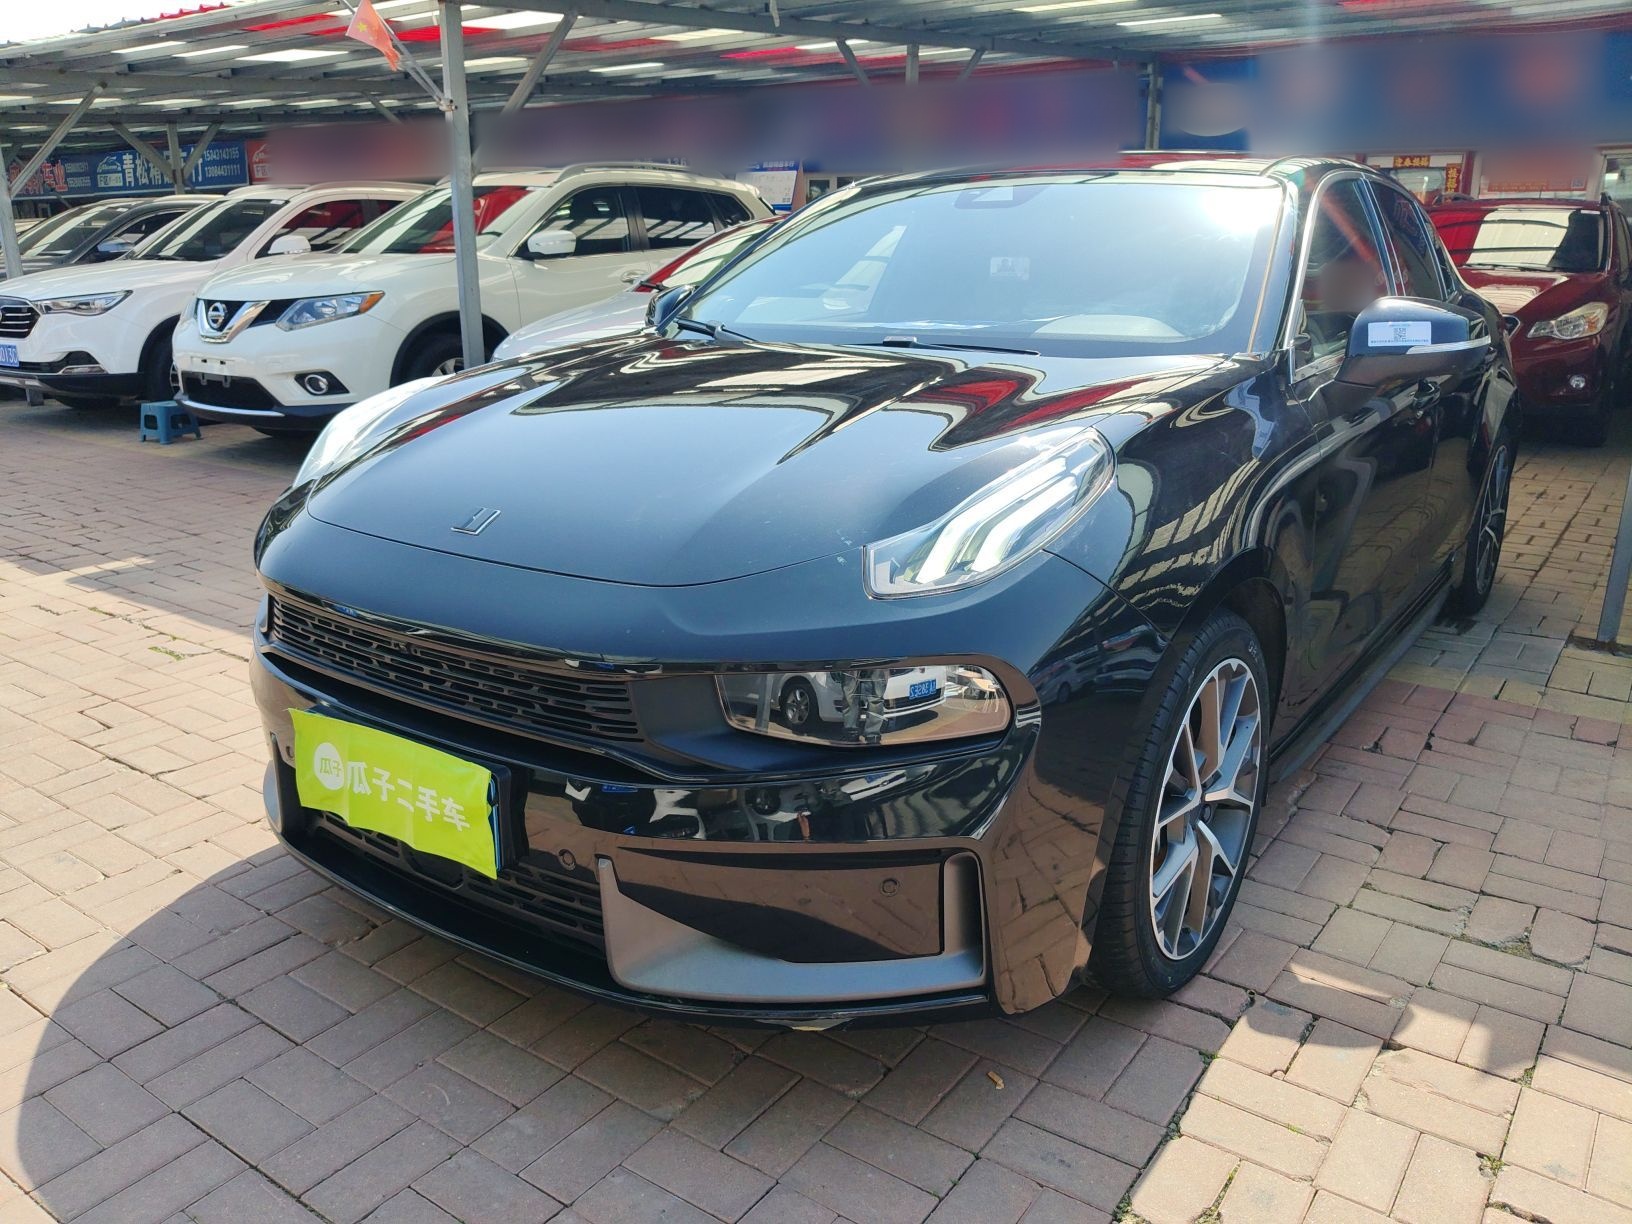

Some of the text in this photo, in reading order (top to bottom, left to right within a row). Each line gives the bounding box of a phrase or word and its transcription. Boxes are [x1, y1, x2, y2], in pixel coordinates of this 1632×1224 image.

[319, 756, 342, 778] 瓜子
[347, 761, 471, 832] 瓜子二手车
